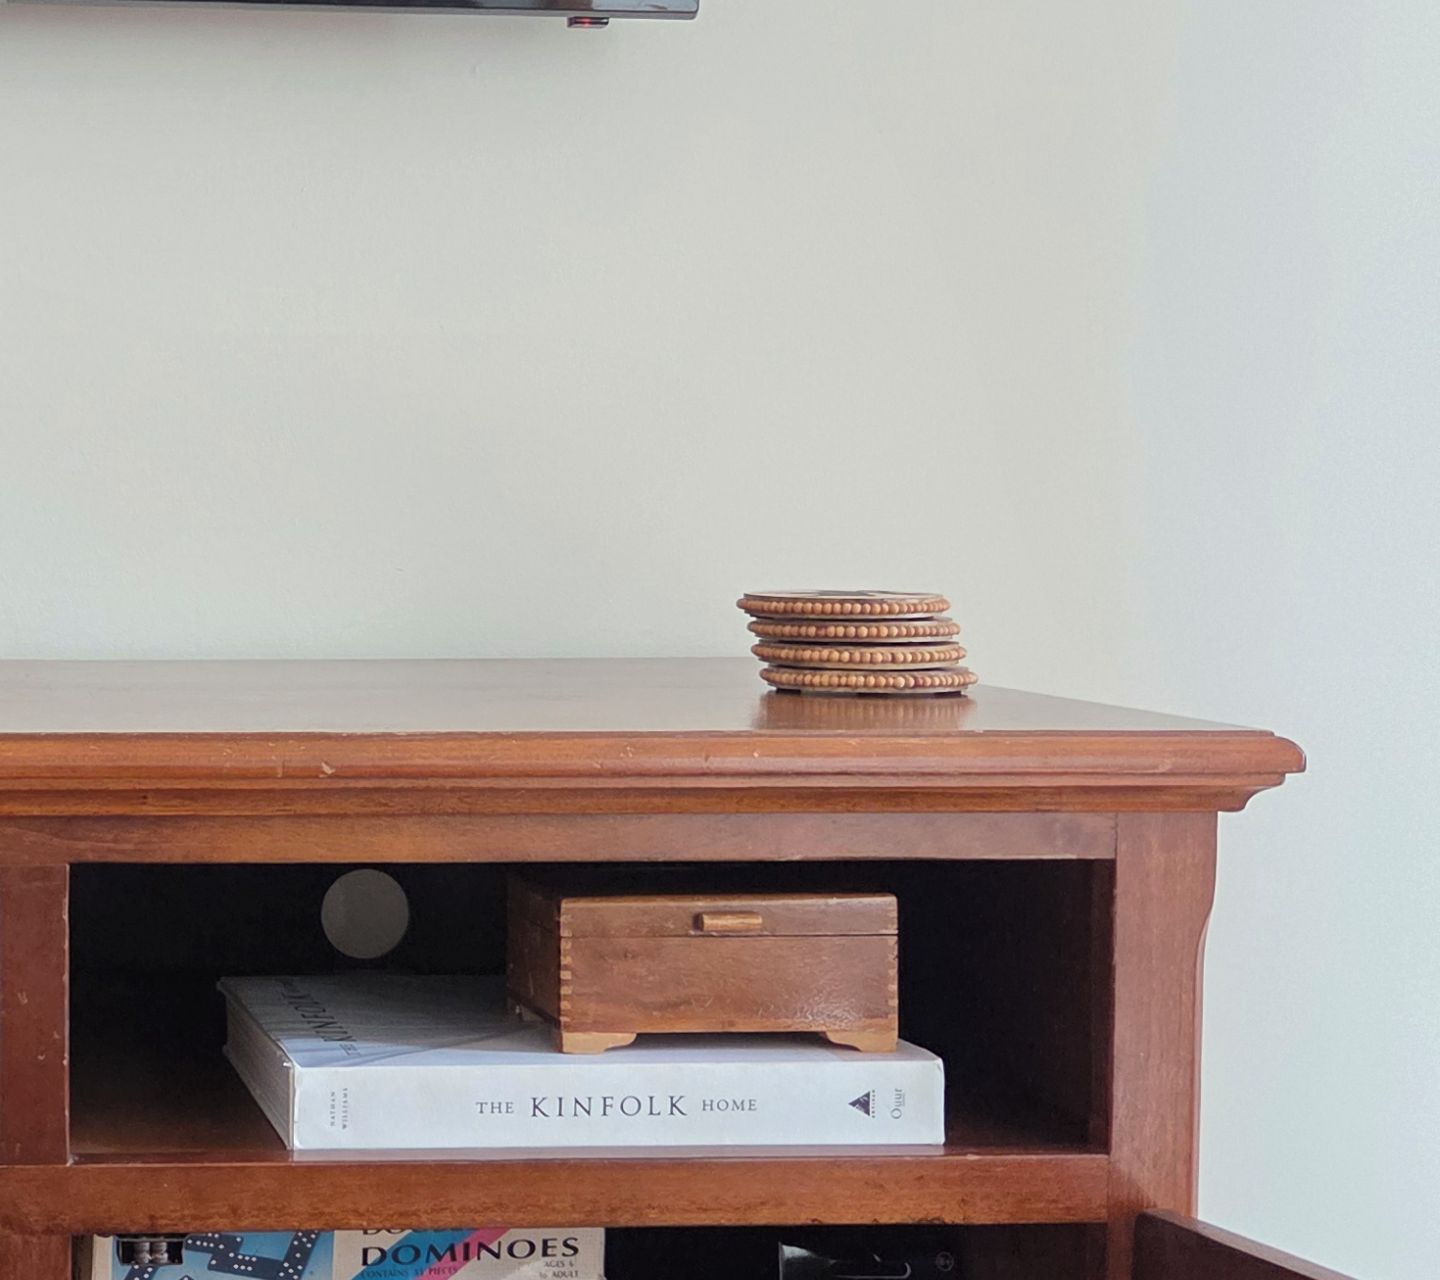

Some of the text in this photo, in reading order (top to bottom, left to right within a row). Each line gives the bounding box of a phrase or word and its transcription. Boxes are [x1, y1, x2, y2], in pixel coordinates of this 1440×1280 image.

[476, 1095, 758, 1118] THE KINFOLK HOME
[361, 1237, 580, 1267] DOMINOES
